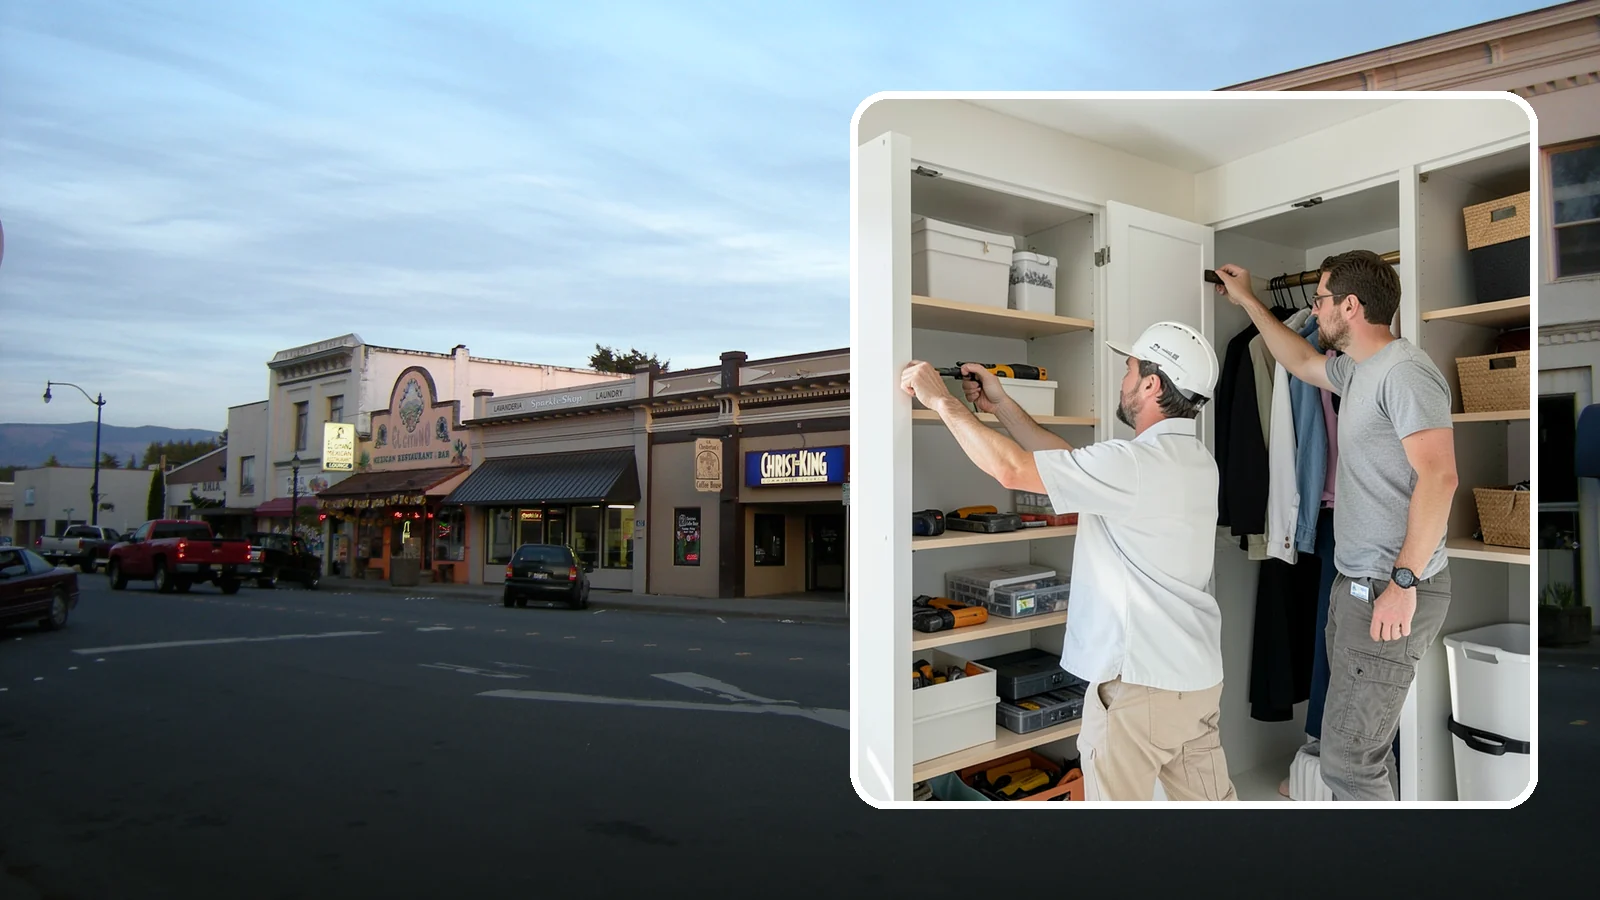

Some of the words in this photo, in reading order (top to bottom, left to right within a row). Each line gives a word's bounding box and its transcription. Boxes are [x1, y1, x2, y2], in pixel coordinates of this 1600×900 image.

[493, 402, 523, 413] LAVANDERIA
[561, 394, 583, 404] Shop
[595, 389, 624, 400] LAUNDRY
[373, 455, 396, 464] MEXICAN
[398, 447, 433, 462] RESTAURANT
[437, 450, 450, 459] BAR
[761, 452, 797, 477] CHRIST
[799, 450, 827, 476] KING
[696, 480, 709, 489] Coffee
